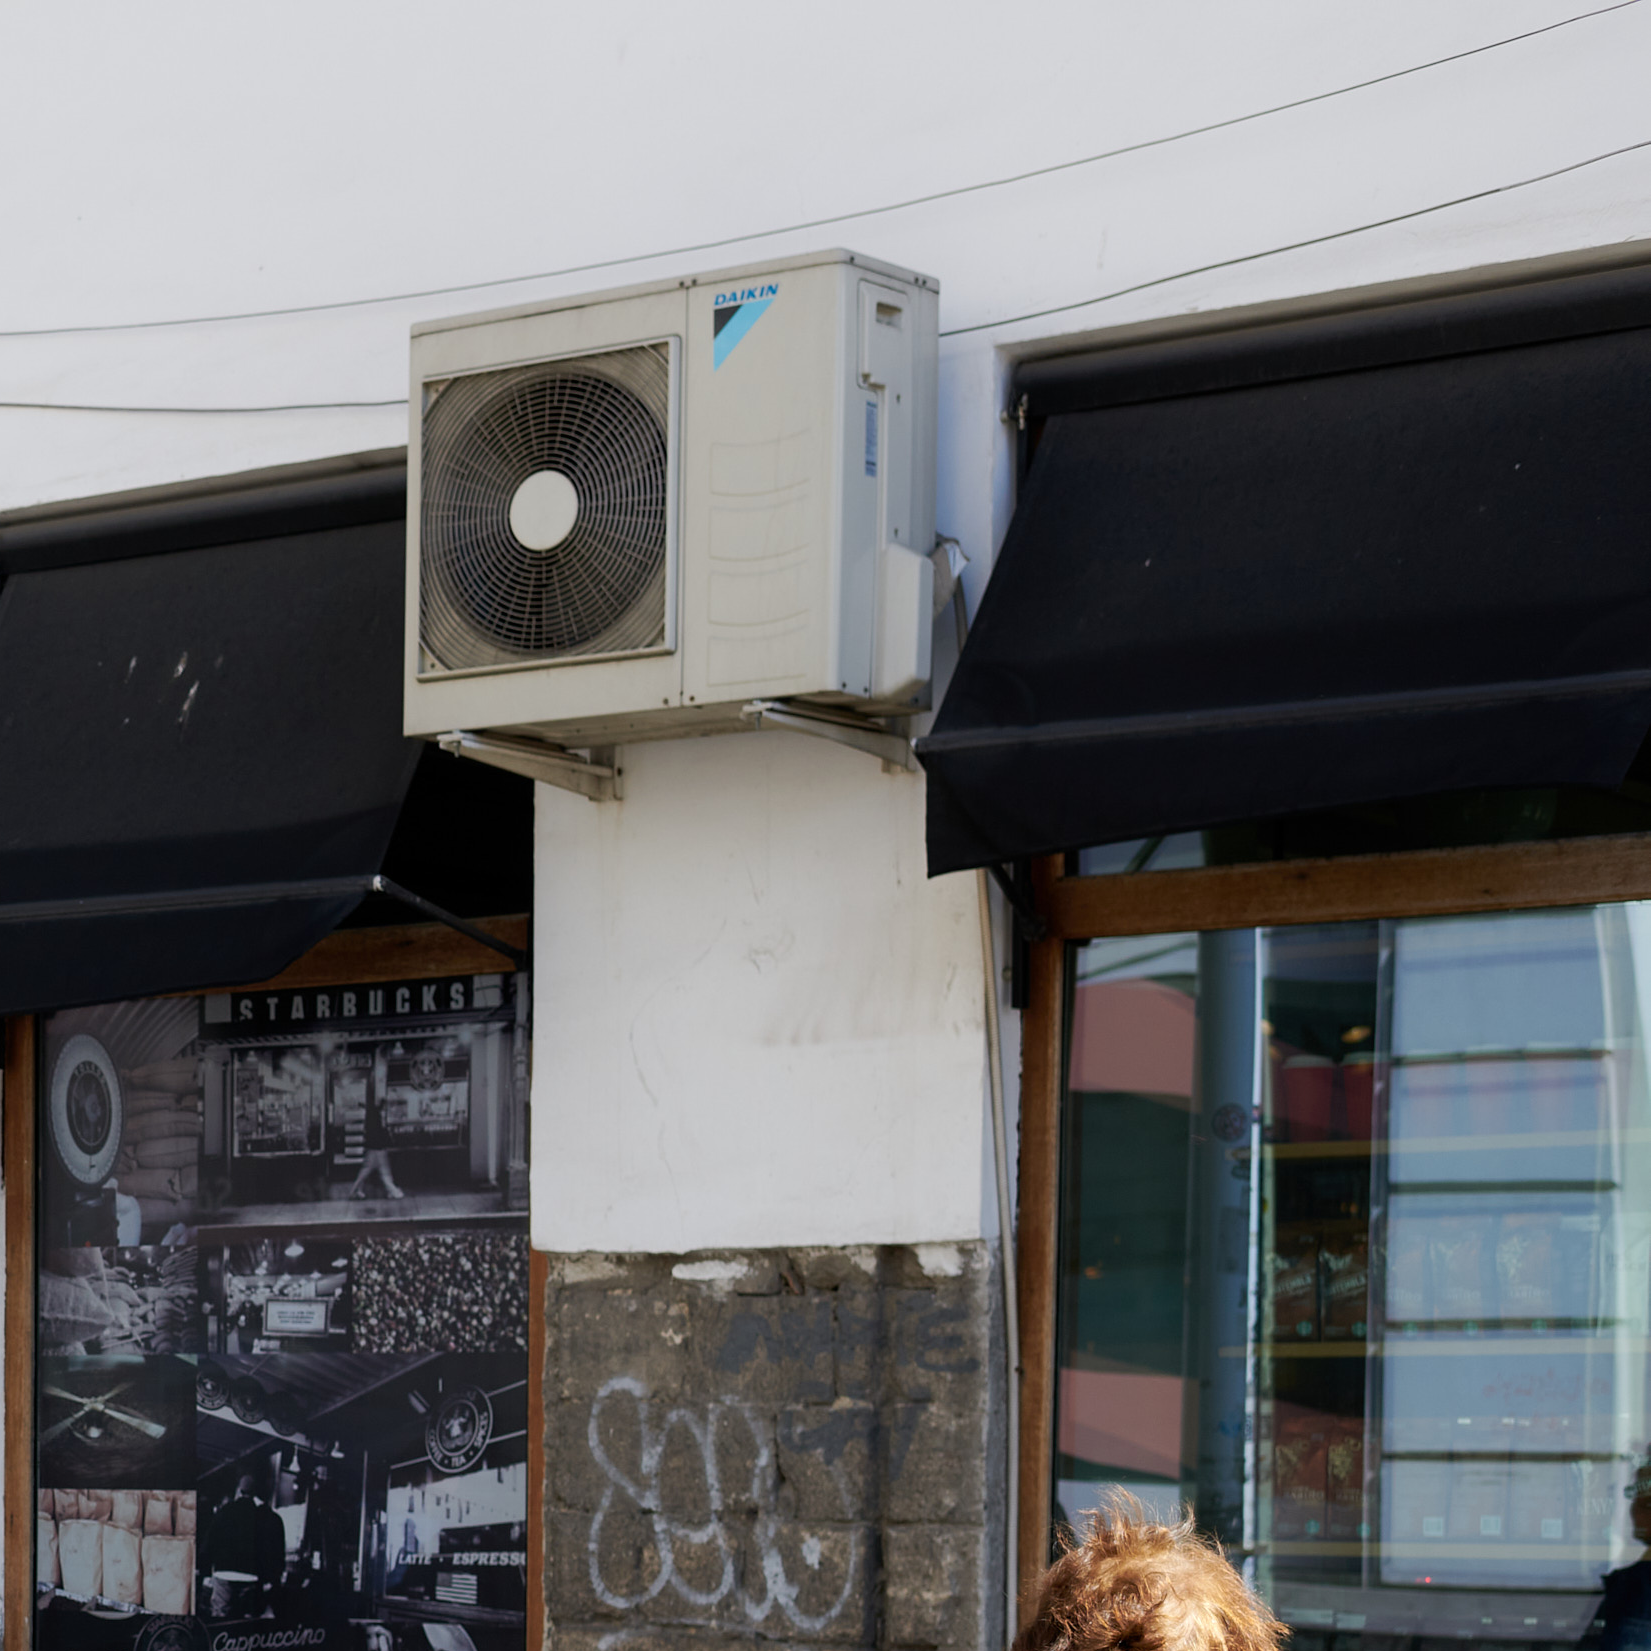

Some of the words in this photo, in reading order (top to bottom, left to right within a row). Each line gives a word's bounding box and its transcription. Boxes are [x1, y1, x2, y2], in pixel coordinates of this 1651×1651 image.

[714, 283, 778, 306] DAIKIN
[239, 982, 465, 1020] STARBUCKS
[399, 1554, 432, 1565] LATTE
